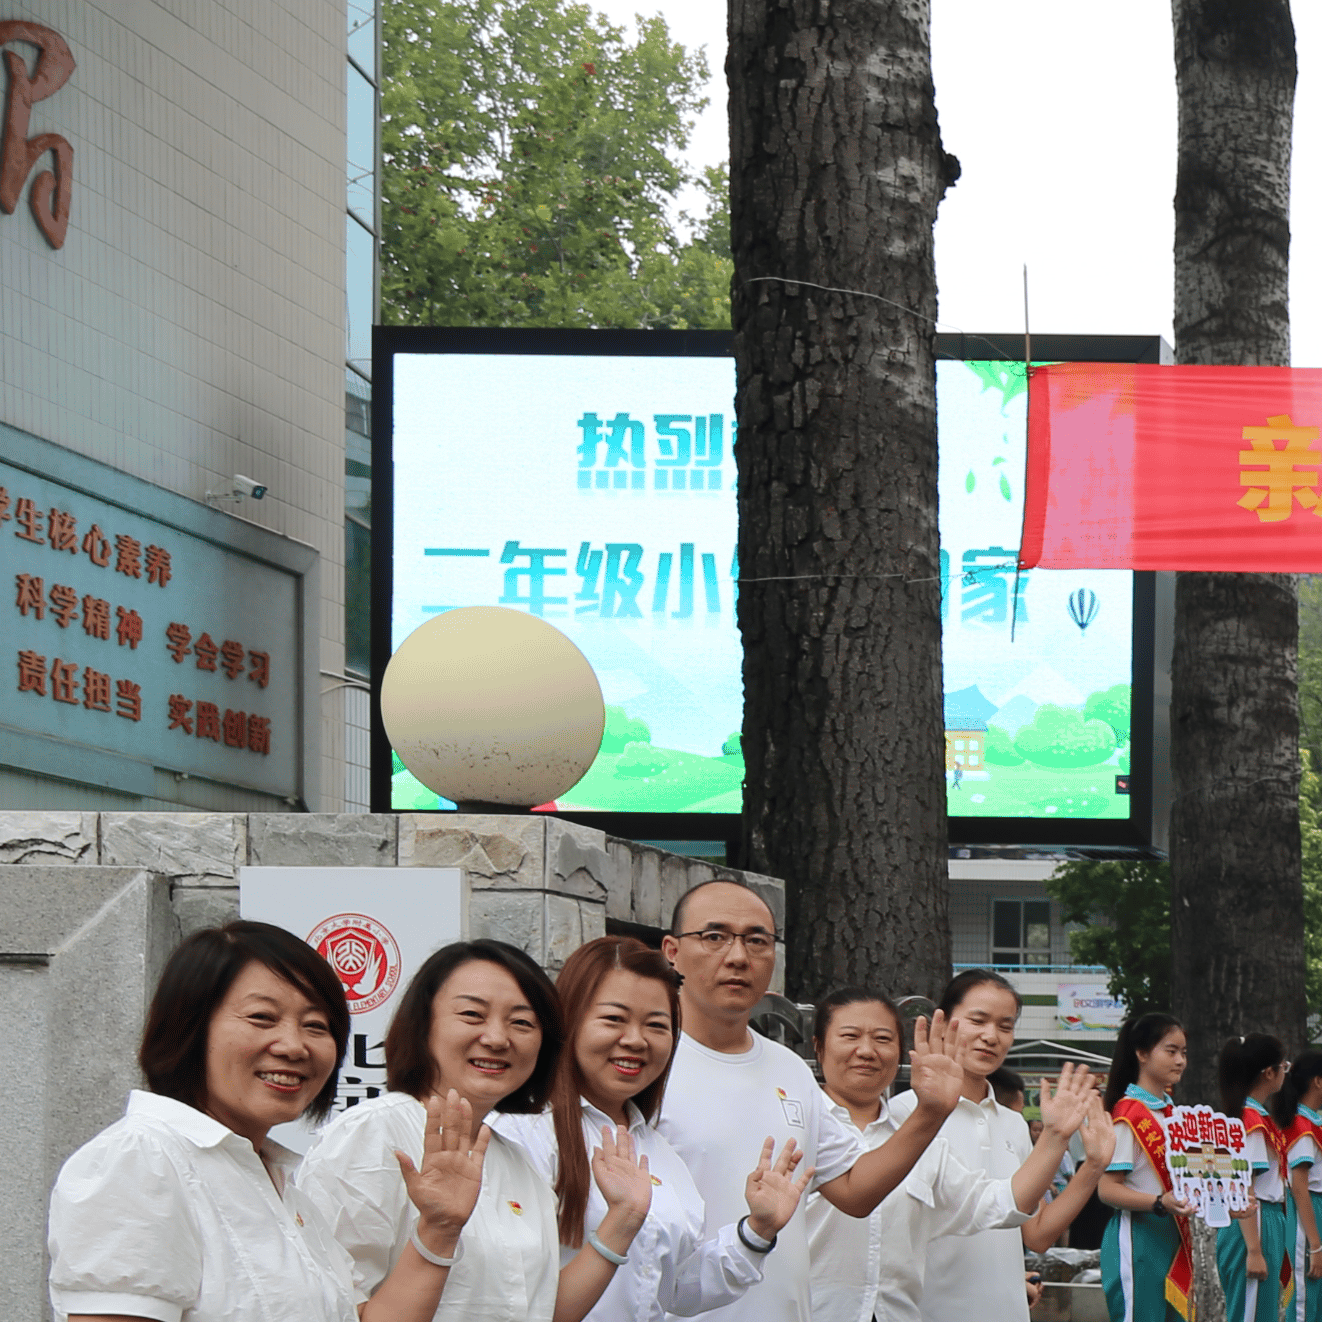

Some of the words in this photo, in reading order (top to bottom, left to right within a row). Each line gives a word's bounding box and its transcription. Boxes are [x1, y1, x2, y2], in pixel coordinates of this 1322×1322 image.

[576, 411, 738, 490] 热烈
[422, 541, 738, 621] 二年级小
[15, 573, 143, 650] 科学精神
[166, 622, 270, 688] 学会学习
[17, 650, 141, 721] 责任担当
[168, 694, 271, 755] 实践创新
[1136, 1117, 1167, 1169] 保定市
[1167, 1110, 1245, 1154] 欢迎新同学
